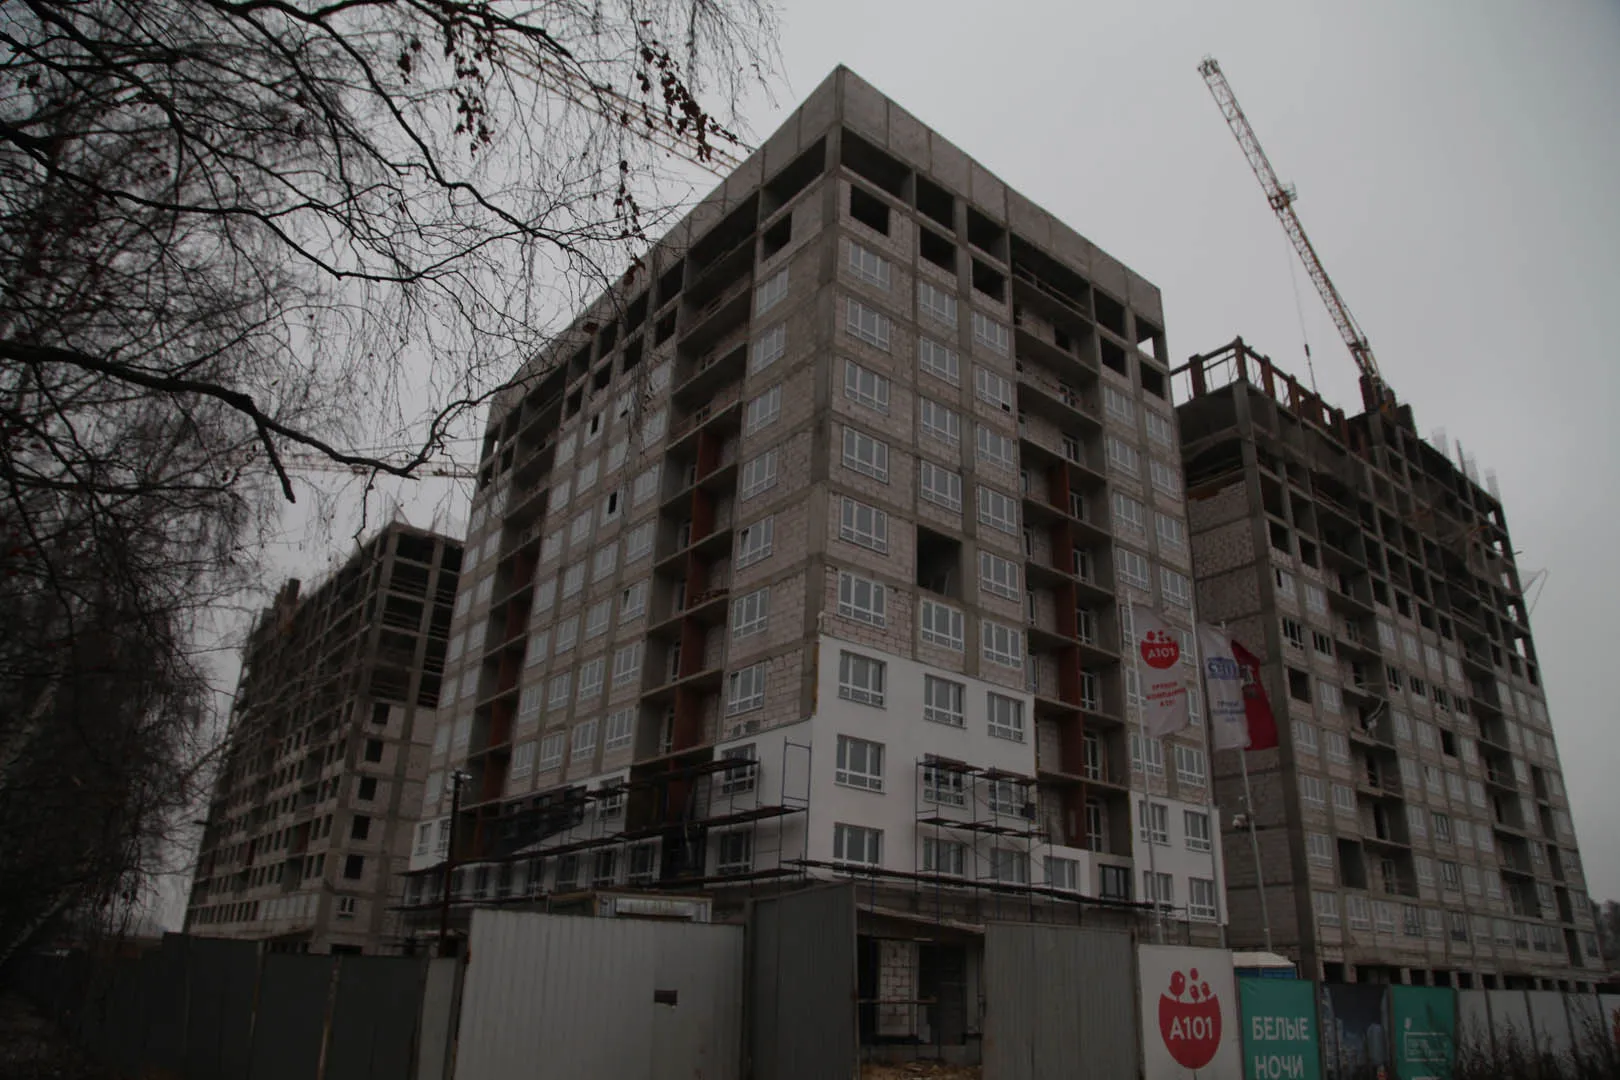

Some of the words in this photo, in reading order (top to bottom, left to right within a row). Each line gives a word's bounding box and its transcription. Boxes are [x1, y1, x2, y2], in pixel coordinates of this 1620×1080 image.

[1169, 1016, 1212, 1040] А101
[1252, 1016, 1309, 1040] БЕЛЫЕ
[1255, 1055, 1304, 1080] НОЧИ
